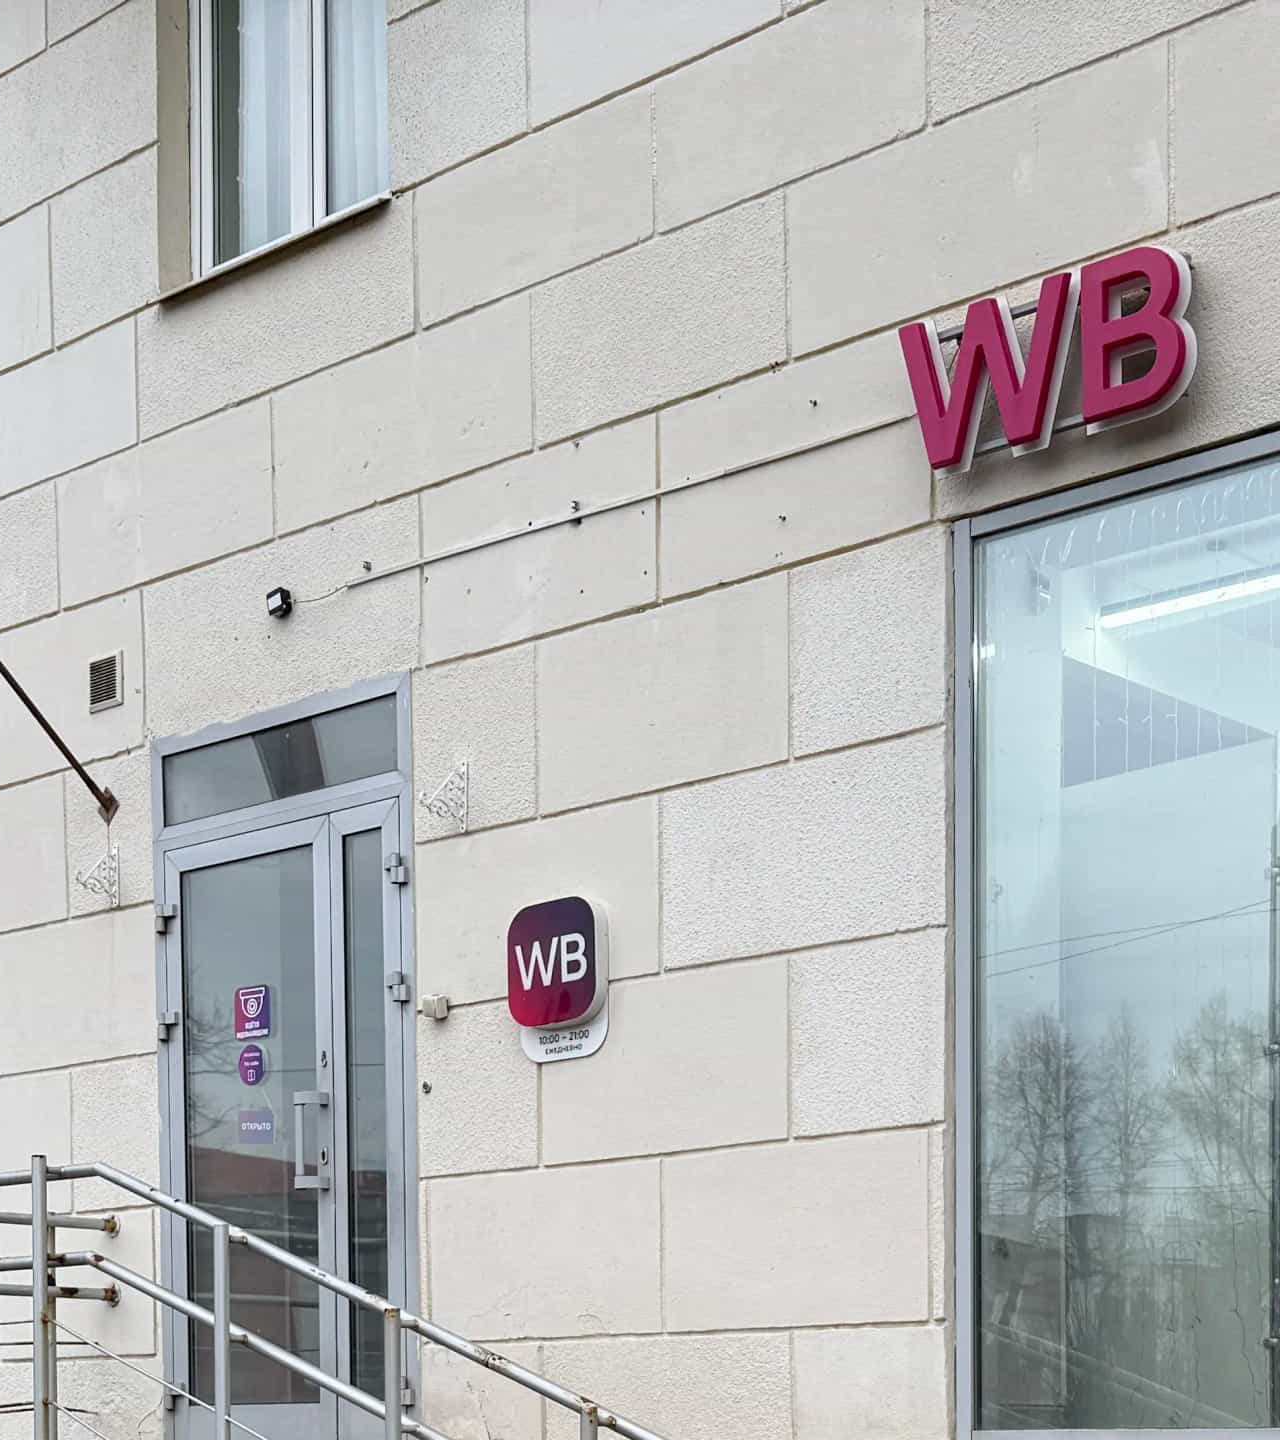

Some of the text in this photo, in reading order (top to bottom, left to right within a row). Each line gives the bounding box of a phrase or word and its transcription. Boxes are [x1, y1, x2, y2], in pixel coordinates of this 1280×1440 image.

[898, 246, 1190, 471] WB
[513, 932, 588, 992] WB
[538, 1033, 560, 1046] 10:00
[568, 1029, 590, 1042] 21:00
